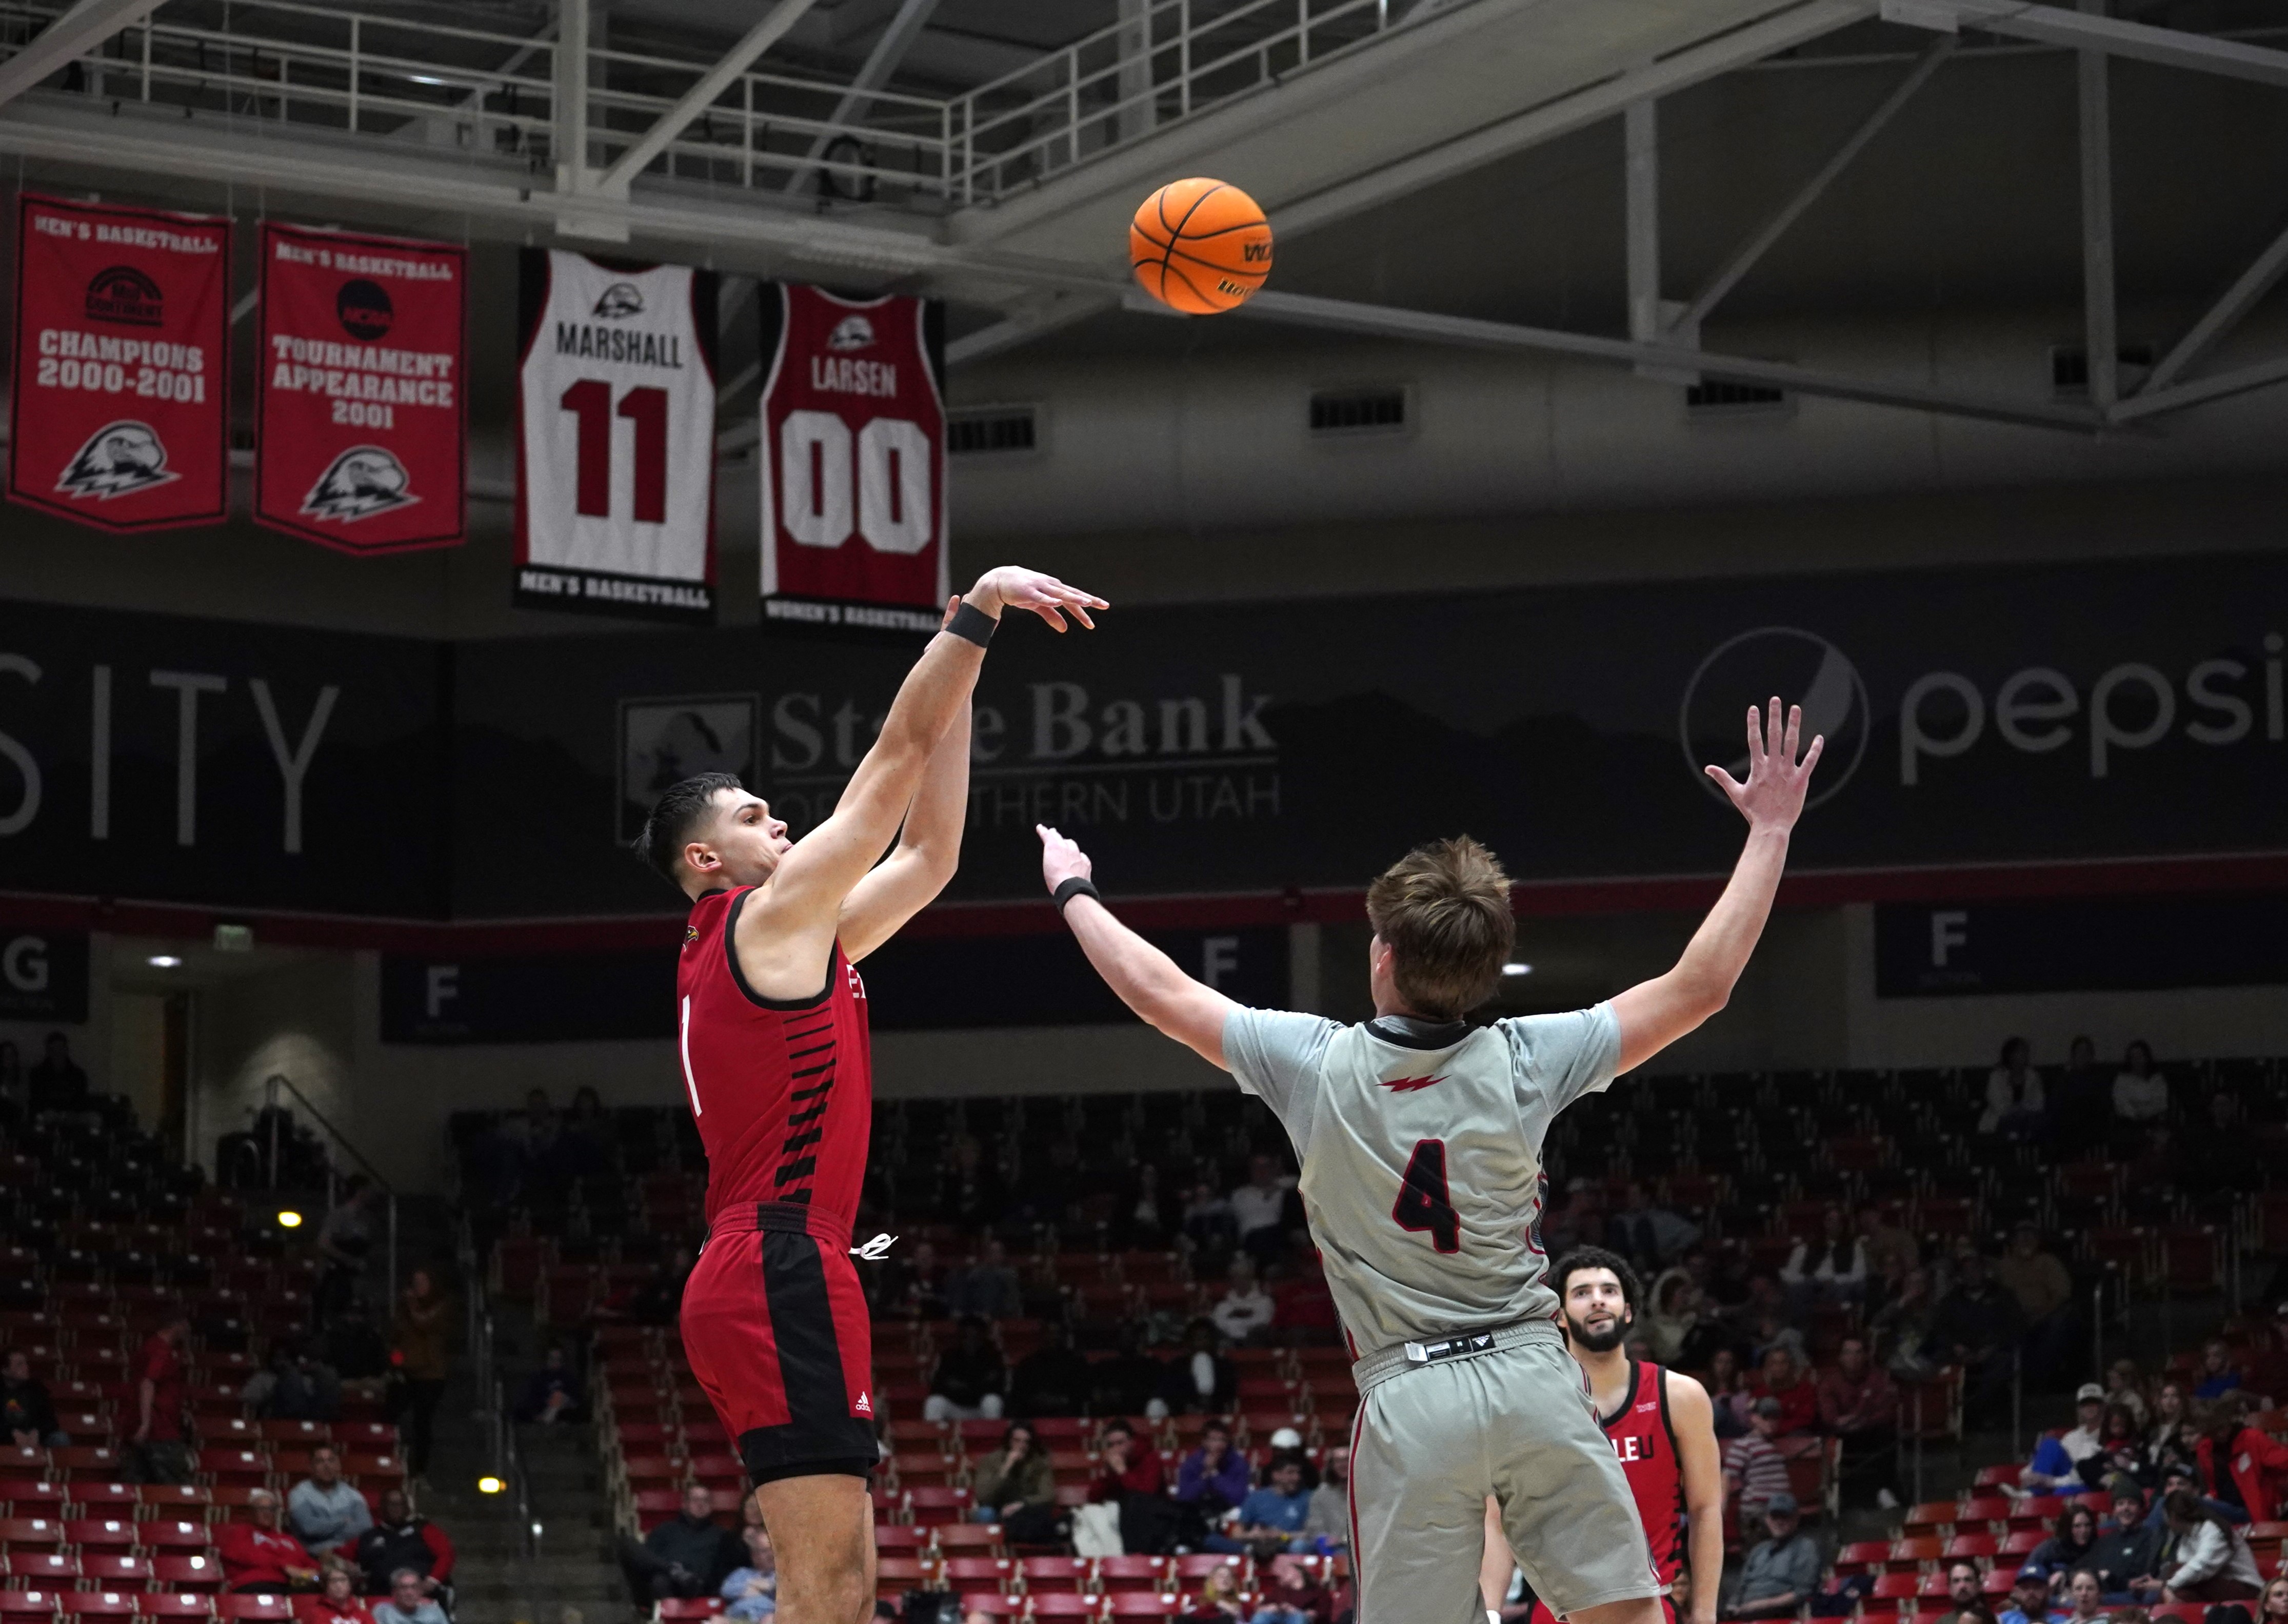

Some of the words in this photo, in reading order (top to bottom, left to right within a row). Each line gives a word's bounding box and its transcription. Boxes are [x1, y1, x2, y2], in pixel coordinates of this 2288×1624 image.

[34, 215, 92, 241] MEN'S
[96, 224, 218, 254] BASKETBALL
[275, 241, 331, 267] MEN'S
[335, 252, 453, 281] BASKETBALL
[39, 329, 204, 372] CHAMPIONS
[272, 334, 454, 378] TOURNAMENT
[555, 322, 683, 370] MARSHALL
[37, 359, 206, 403] 2000-2001
[272, 363, 454, 408] APPEARANCE
[810, 355, 897, 398] LARSEN
[332, 400, 393, 429] 2001
[561, 378, 668, 524] 11
[780, 410, 932, 556] 00
[520, 570, 581, 596] MEN'S
[585, 577, 710, 609] BASKETBALL
[765, 599, 841, 624] WOMEN'S
[844, 606, 945, 632] BASKETBAL
[1028, 674, 1278, 760] Bank
[1900, 633, 2286, 786] pepsi
[1148, 774, 1281, 821] UTAH
[1203, 934, 1240, 989] F
[1931, 910, 1968, 967] F
[3, 935, 49, 992] G
[426, 964, 459, 1017] F
[1392, 1139, 1460, 1253] 4
